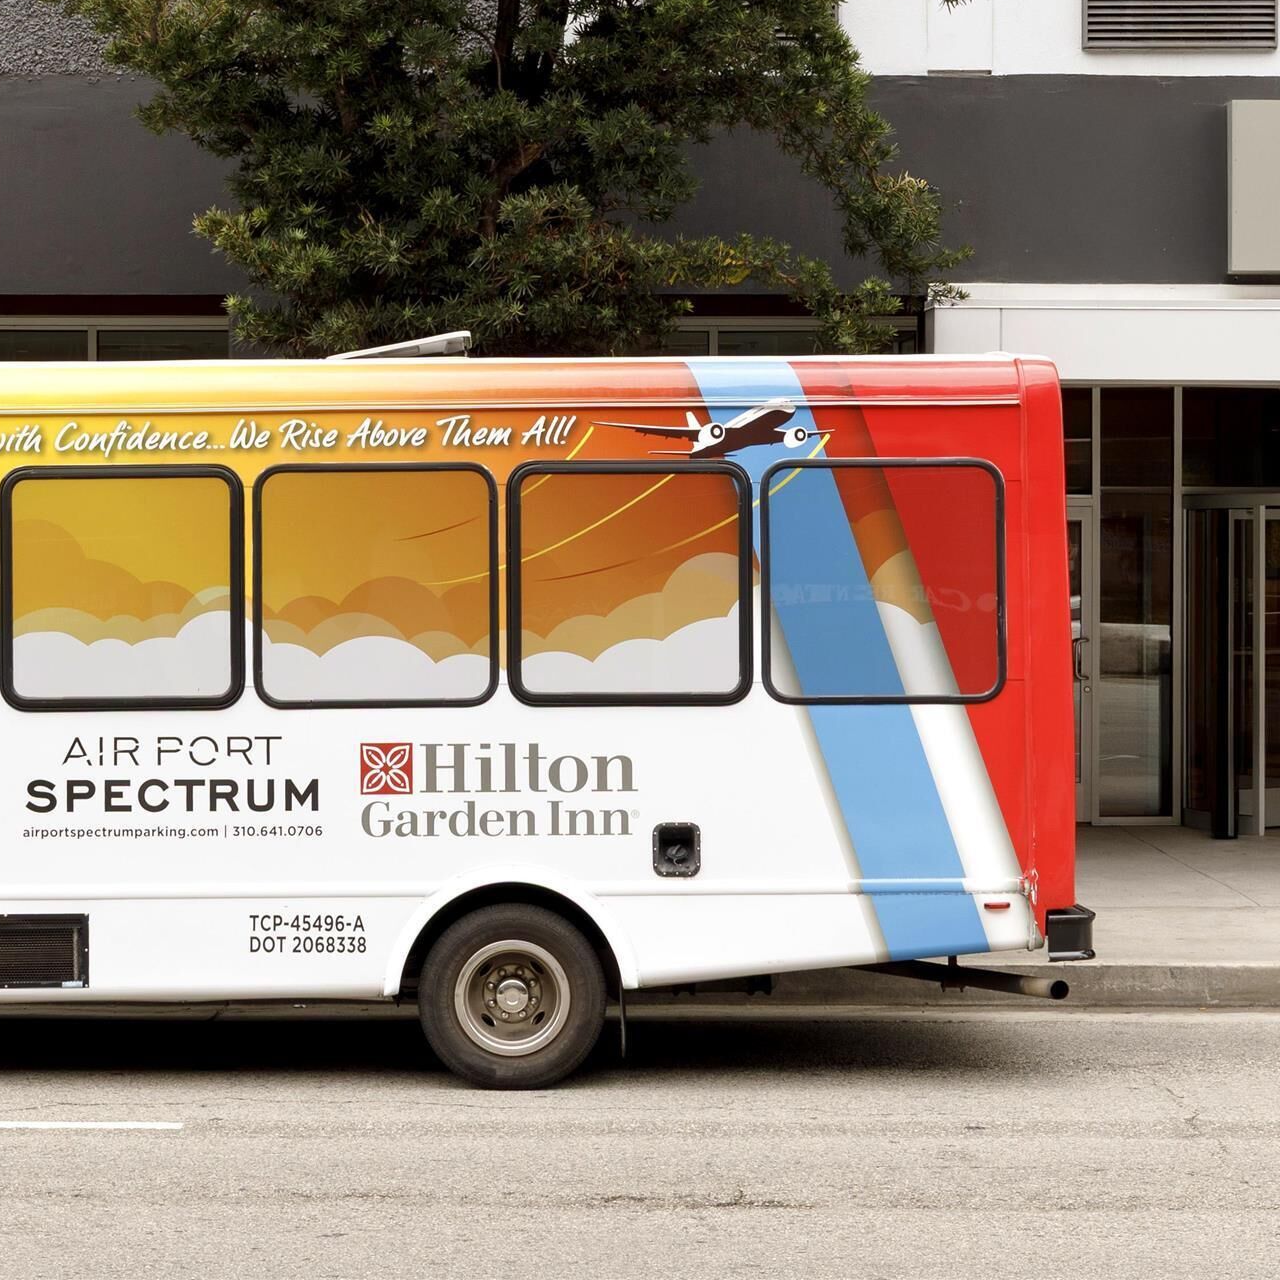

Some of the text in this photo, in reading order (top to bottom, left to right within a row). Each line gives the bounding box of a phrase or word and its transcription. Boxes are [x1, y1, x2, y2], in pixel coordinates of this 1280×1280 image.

[278, 419, 338, 451] Rise
[346, 417, 427, 449] Above
[436, 414, 512, 447] Them
[521, 415, 577, 447] All!
[419, 742, 639, 794] Hilton
[25, 778, 319, 814] SPECTRUM
[23, 825, 323, 840] airportspectrumparking.com 310.641.0706
[361, 800, 537, 838] Garden
[249, 914, 365, 932] TCP-45496-A
[249, 935, 367, 954] DOT 2068338
